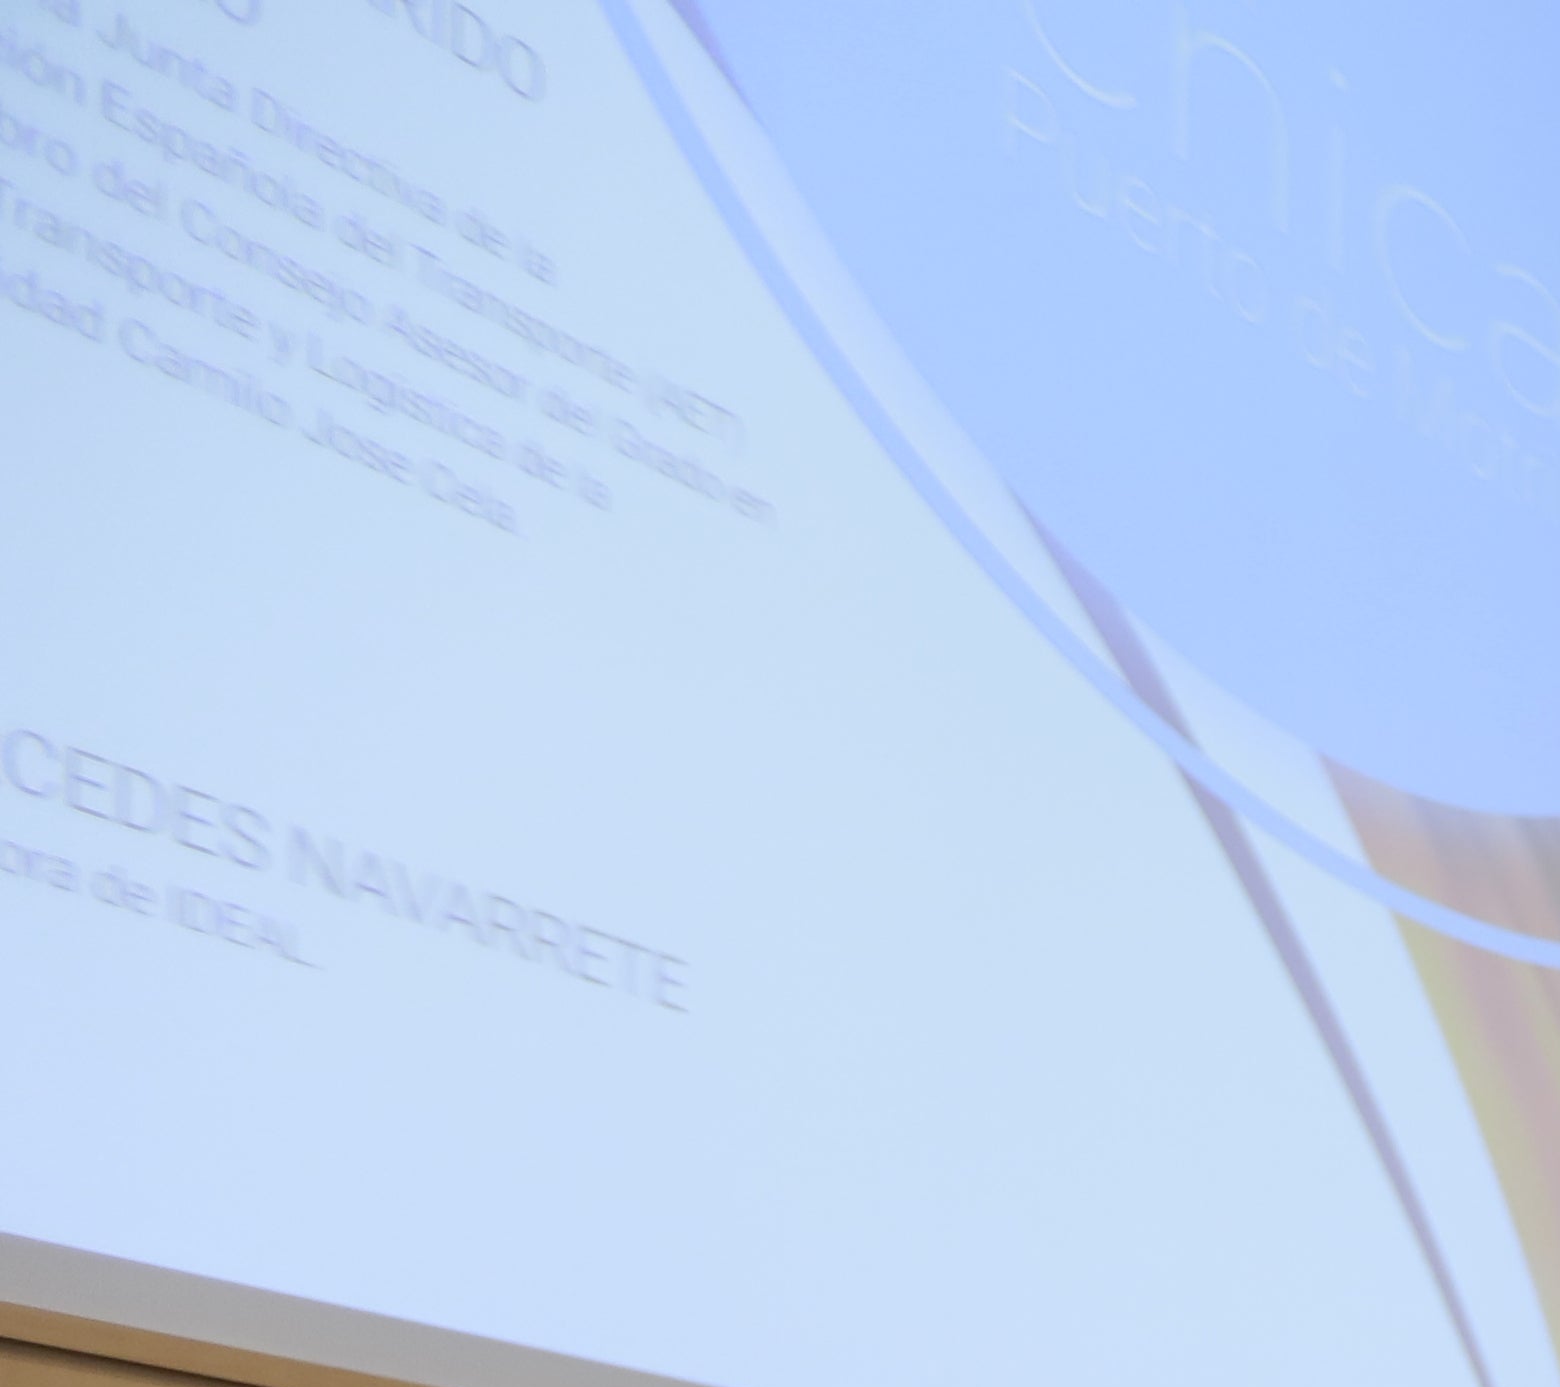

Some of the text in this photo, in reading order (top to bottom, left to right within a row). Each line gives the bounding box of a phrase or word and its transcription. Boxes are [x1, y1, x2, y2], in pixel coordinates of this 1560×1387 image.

[0, 26, 87, 107] ión
[100, 79, 325, 232] Española
[333, 210, 402, 269] del
[405, 241, 640, 395] Transporte
[95, 12, 238, 113] Junta
[250, 86, 448, 229] Directiva
[454, 207, 512, 262] de
[1000, 63, 1270, 326] Puerto
[1290, 295, 1376, 401] de
[92, 160, 168, 221] del
[179, 198, 374, 326] Consejo
[381, 304, 534, 400] Asesor
[117, 317, 294, 431] Camilo
[0, 726, 693, 1016] CEDES NAVARRETE
[162, 879, 328, 973] IDEAL
